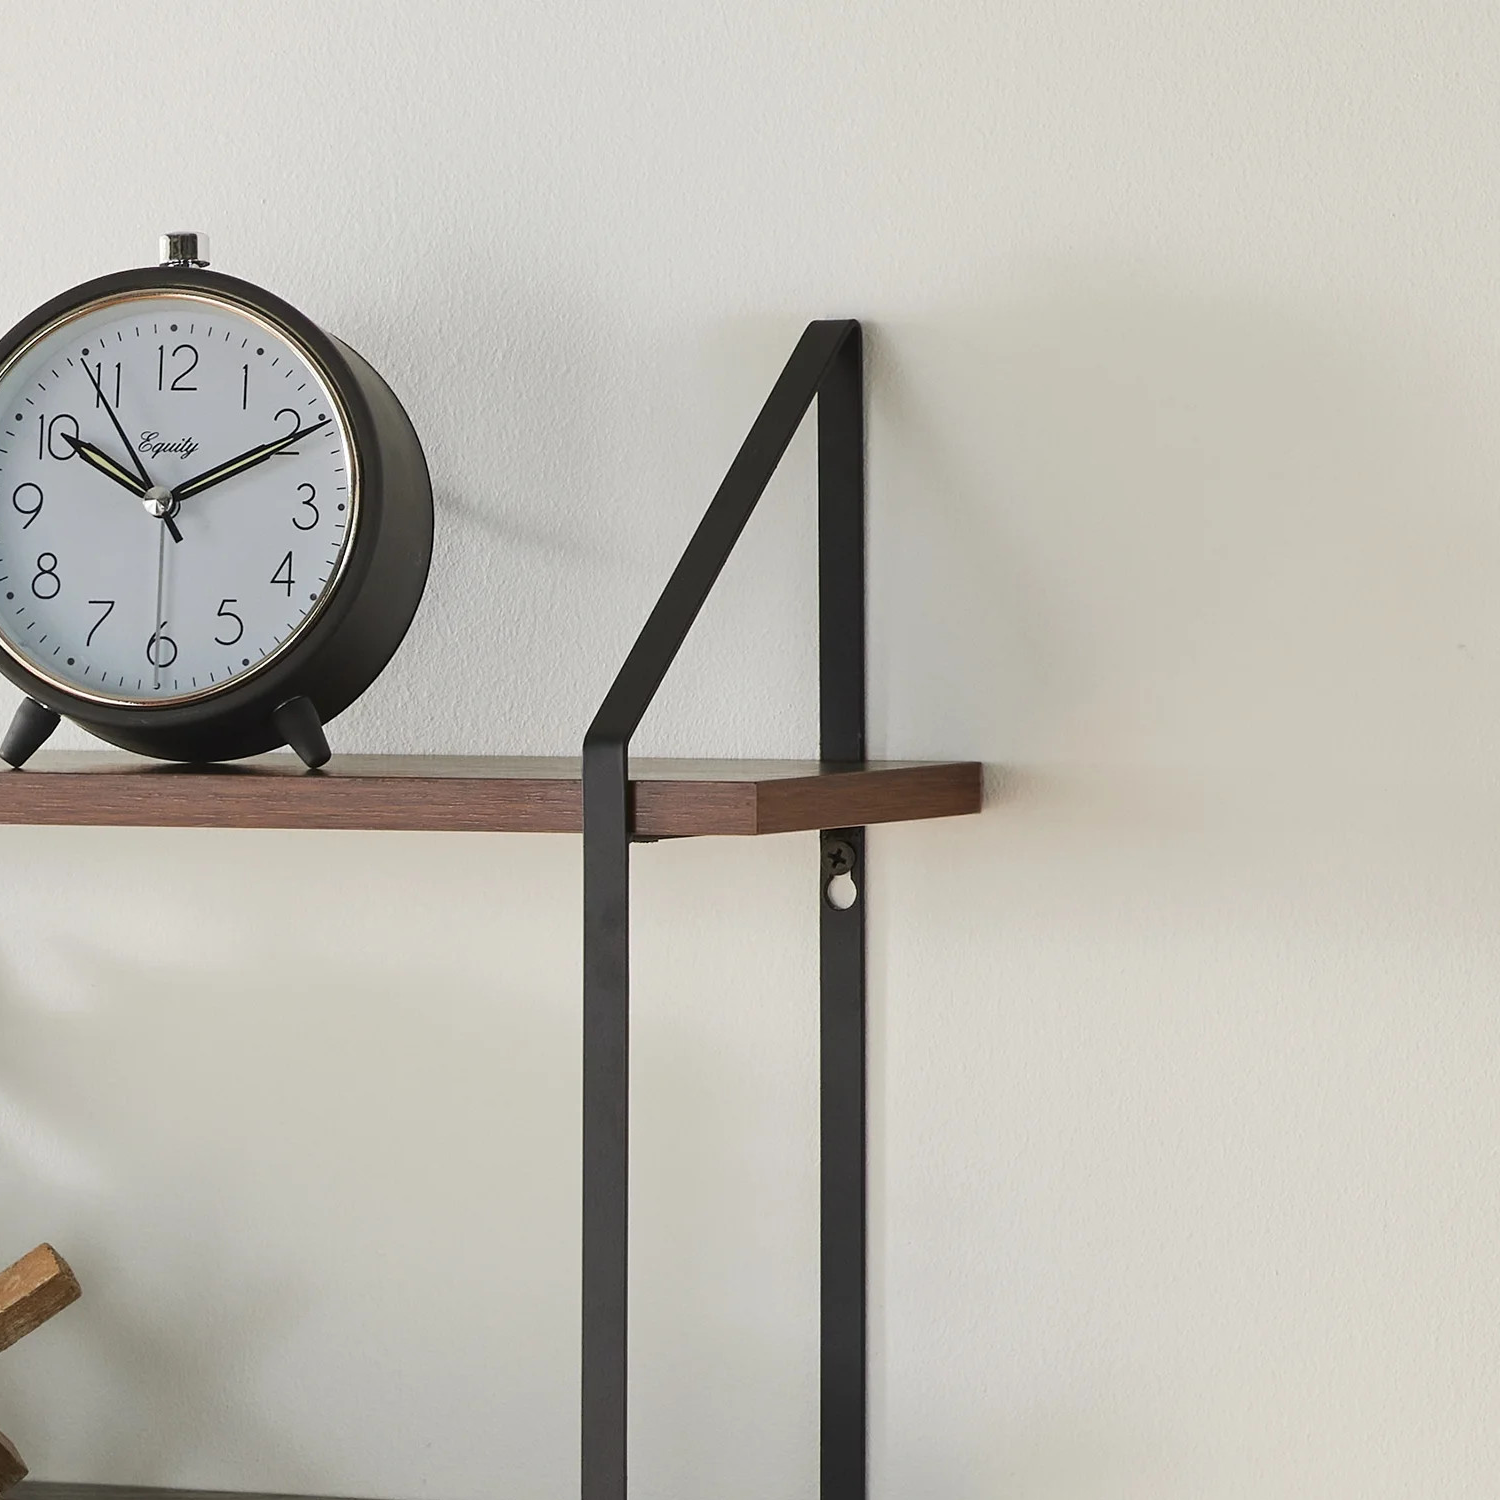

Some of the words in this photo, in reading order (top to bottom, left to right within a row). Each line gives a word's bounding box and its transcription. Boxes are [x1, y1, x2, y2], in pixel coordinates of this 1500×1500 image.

[95, 361, 122, 409] 11
[157, 343, 199, 392] 12
[242, 363, 249, 410] 1
[38, 413, 80, 461] 10
[137, 430, 199, 462] Equity
[273, 407, 300, 456] 2
[12, 482, 44, 530] 9
[292, 482, 319, 531] 3
[31, 551, 61, 600] 8
[269, 550, 296, 597] 4
[86, 600, 115, 647] 7
[146, 621, 178, 668] 6
[214, 599, 244, 646] 5
